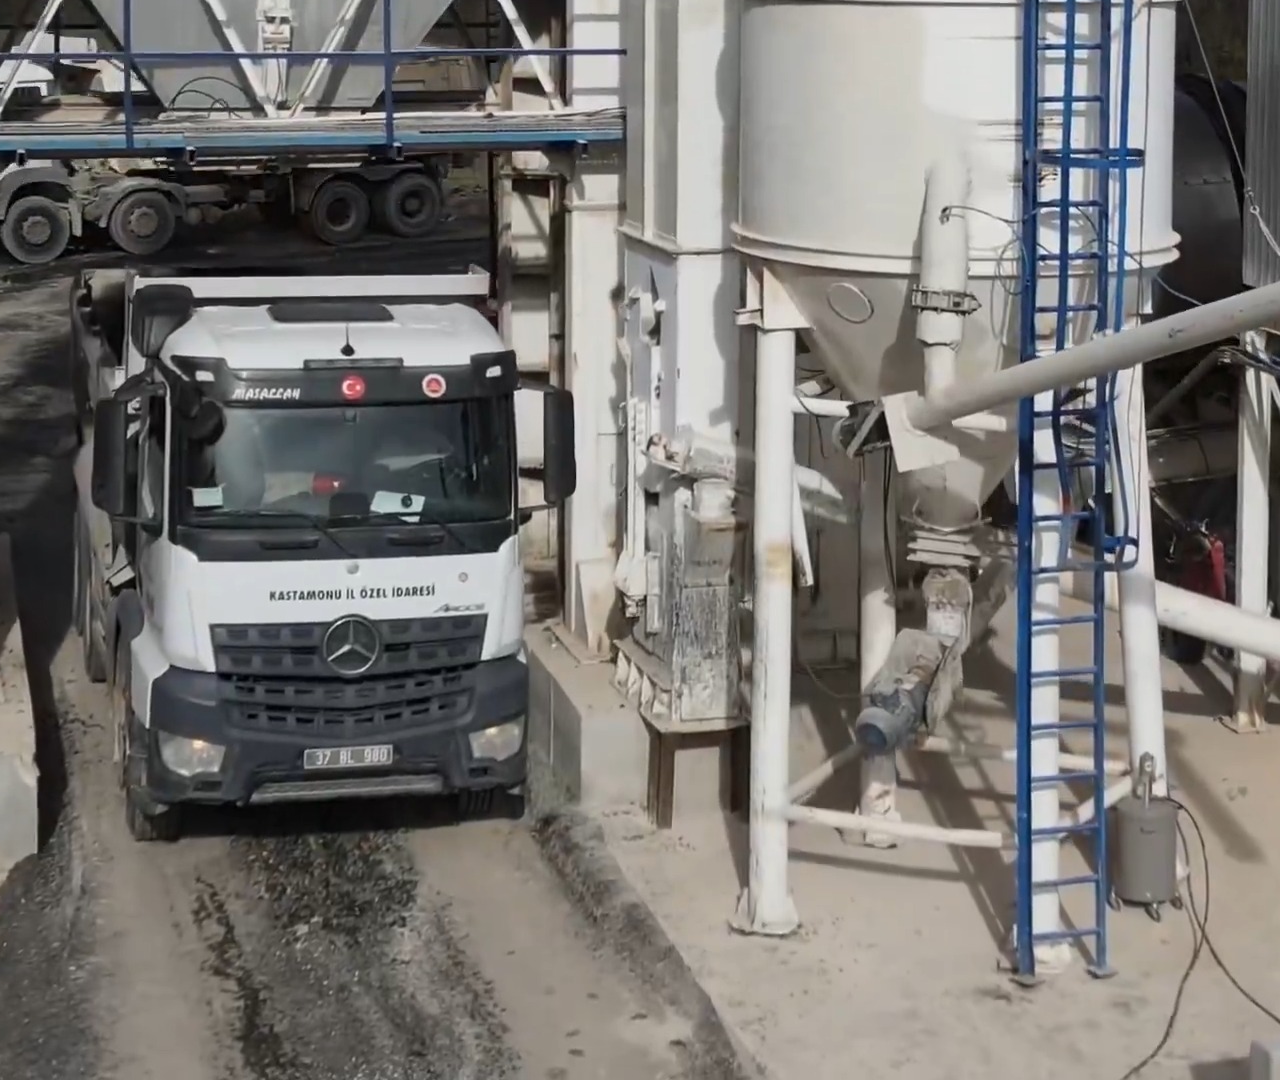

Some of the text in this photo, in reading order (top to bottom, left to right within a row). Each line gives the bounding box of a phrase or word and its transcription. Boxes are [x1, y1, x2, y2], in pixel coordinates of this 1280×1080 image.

[269, 582, 436, 601] KASTAMONU İL ÖZEL İDARESİ
[315, 751, 331, 765] 37
